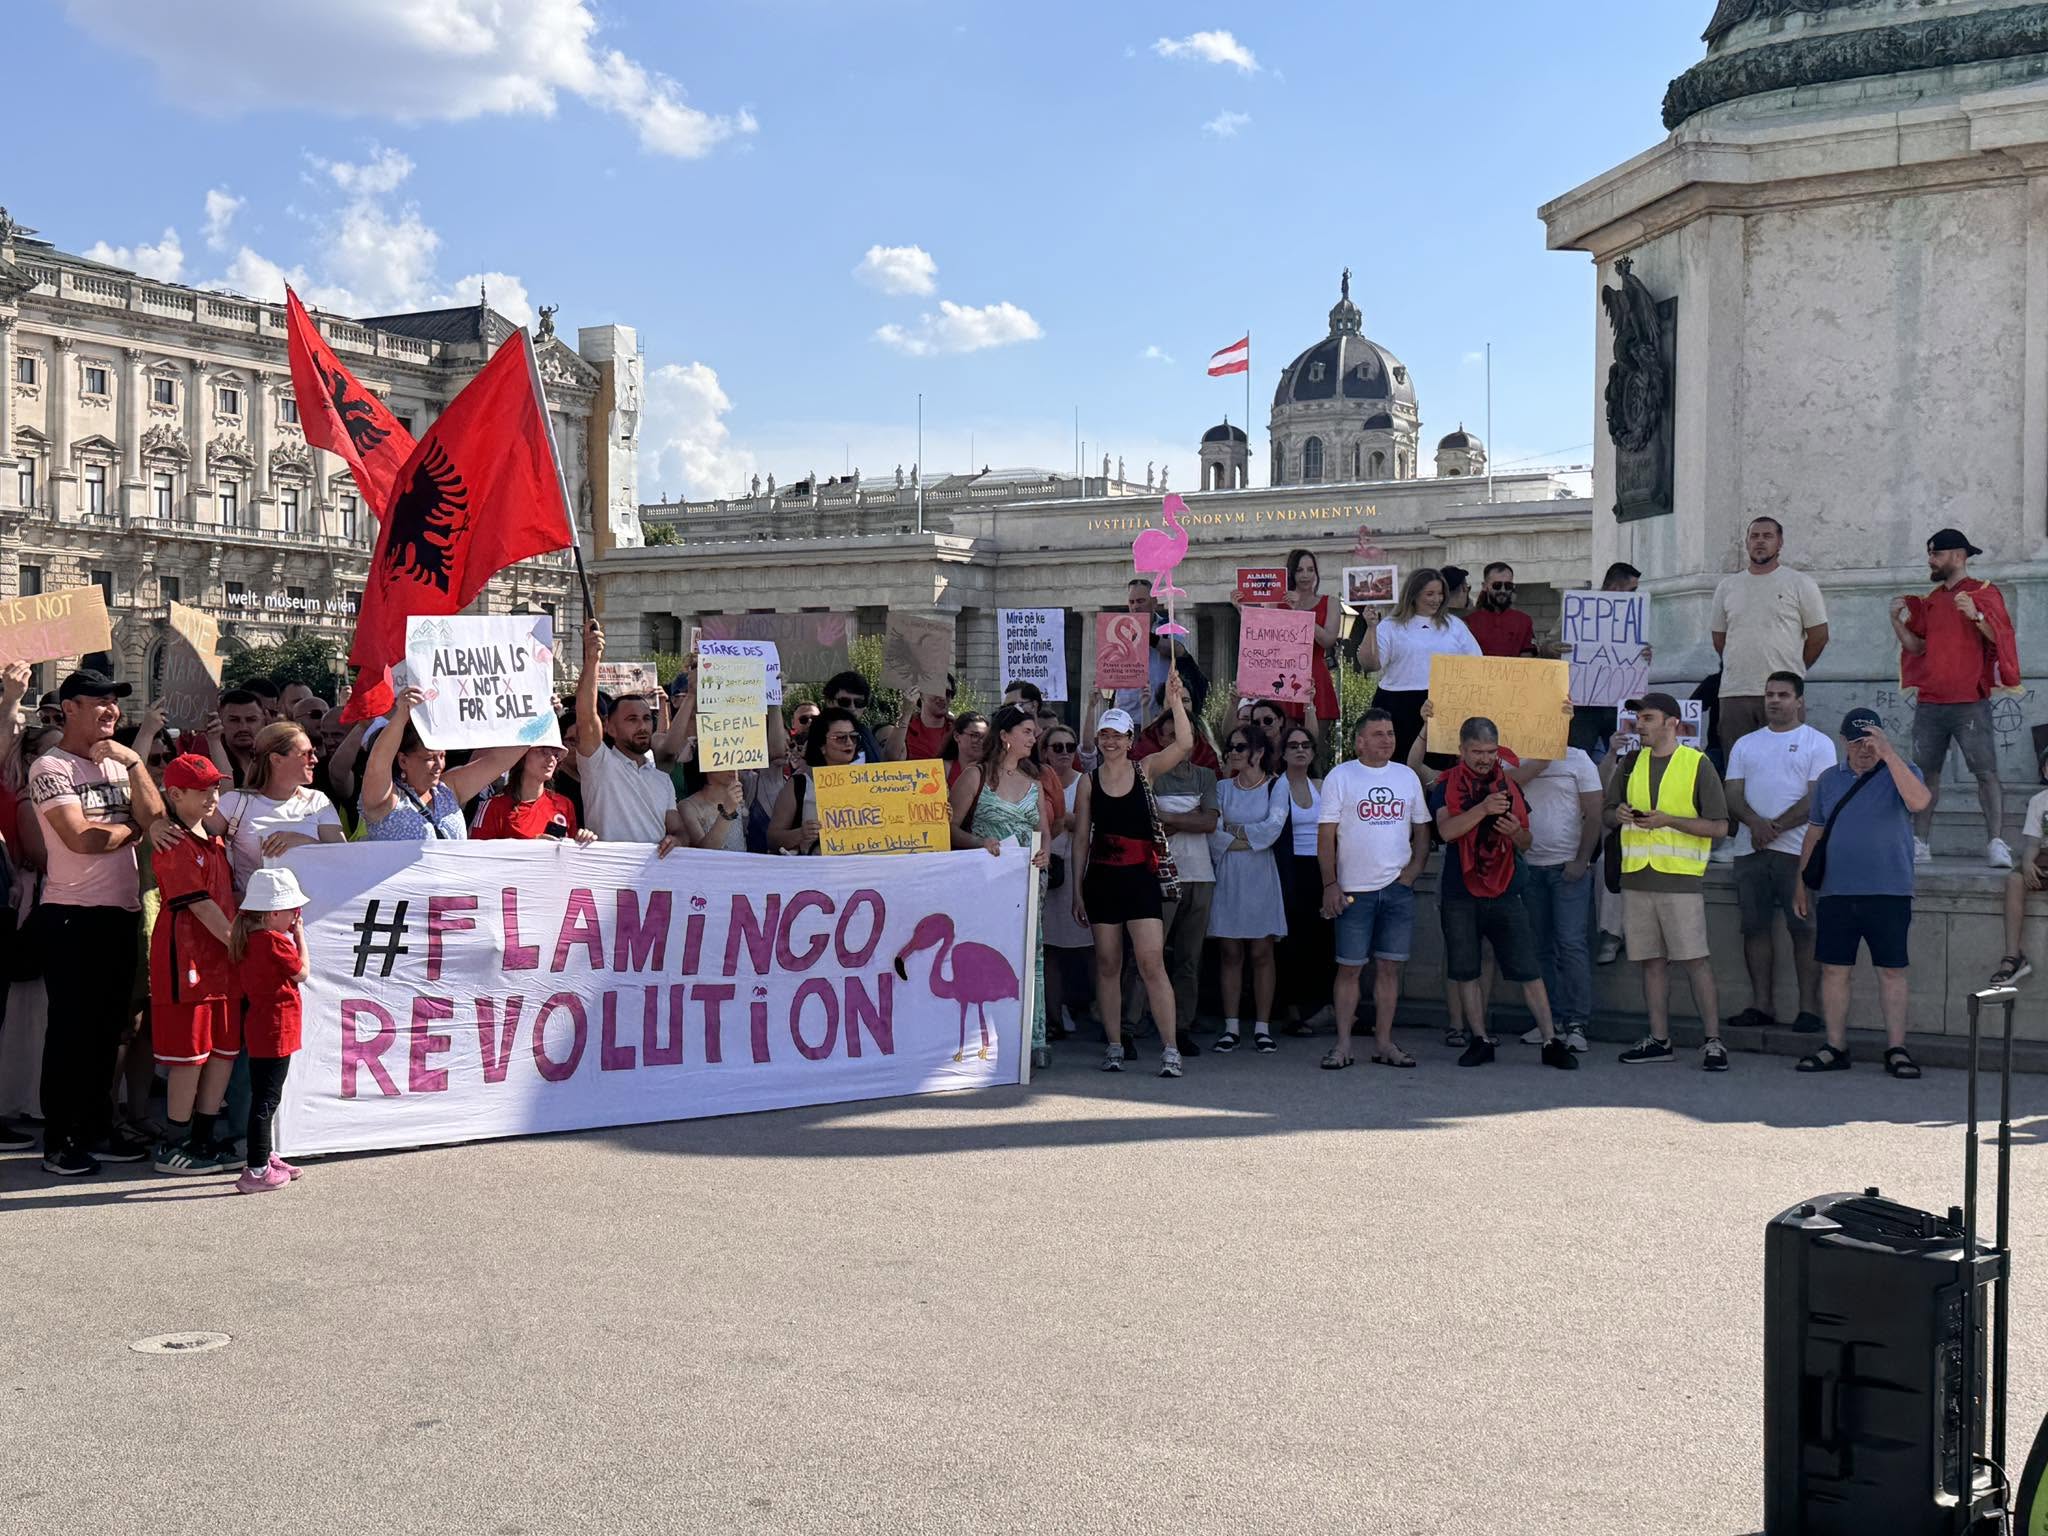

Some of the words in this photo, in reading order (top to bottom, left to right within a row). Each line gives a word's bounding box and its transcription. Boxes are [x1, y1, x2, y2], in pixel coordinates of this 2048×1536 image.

[1162, 511, 1246, 528] RGNORVM
[1256, 505, 1377, 523] FVNDAMENTVM
[11, 603, 26, 623] IS
[35, 594, 73, 621] NOT
[228, 590, 258, 606] welt
[264, 595, 320, 610] museum
[325, 596, 356, 613] wien
[1006, 612, 1023, 624] Mirë
[1036, 612, 1046, 624] ke
[1563, 594, 1648, 645] REPEAL
[743, 646, 763, 656] DES
[1007, 639, 1029, 654] gjithë
[1573, 643, 1643, 666] LAW
[432, 644, 506, 677] ALBANIA
[509, 644, 529, 673] IS
[1008, 655, 1020, 667] por
[1022, 652, 1048, 664] kërkon
[1440, 659, 1472, 681] THE
[1482, 660, 1529, 682] POWER
[473, 676, 500, 696] NOT
[1440, 683, 1496, 706] PEOPLE
[1511, 685, 1529, 708] IS
[459, 697, 487, 721] FOR
[496, 694, 537, 720] SALE
[1685, 702, 1699, 718] IS
[701, 715, 760, 733] REPEAL
[714, 736, 744, 747] LAW
[818, 772, 845, 788] 2026
[849, 770, 869, 784] Still
[872, 770, 913, 782] defending
[915, 768, 929, 779] the
[825, 807, 881, 828] NATURE
[908, 801, 948, 821] MONEY
[1359, 800, 1405, 819] GUCCI
[827, 837, 845, 851] Not
[852, 843, 865, 854] up
[868, 838, 881, 848] for
